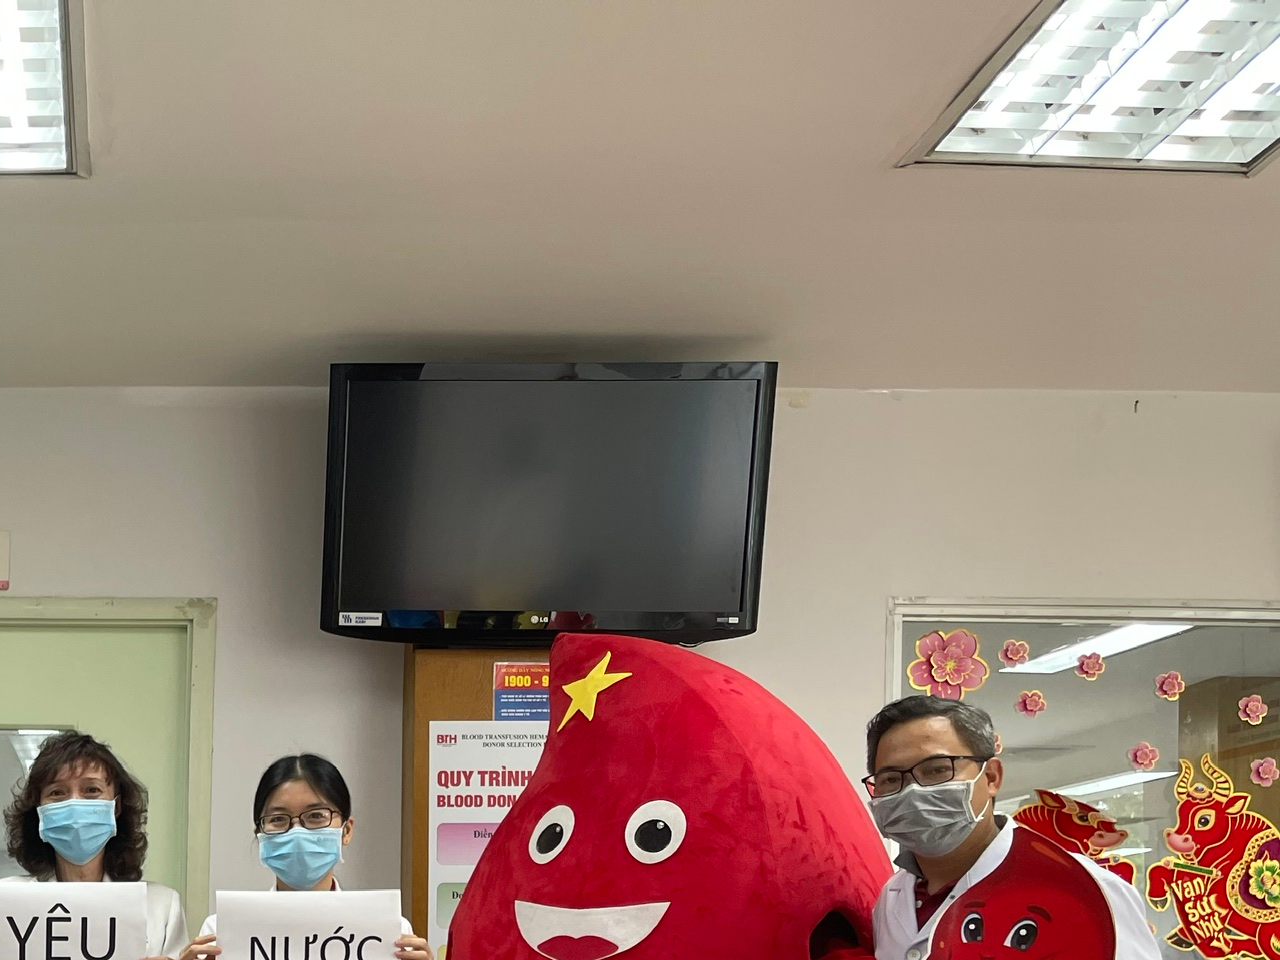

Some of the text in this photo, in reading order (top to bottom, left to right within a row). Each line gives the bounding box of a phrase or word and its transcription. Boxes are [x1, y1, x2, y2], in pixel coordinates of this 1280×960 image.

[504, 676, 531, 687] 1900
[437, 734, 457, 744] BTH
[437, 766, 532, 788] QUY TRÌNH
[437, 795, 483, 808] BLOOD
